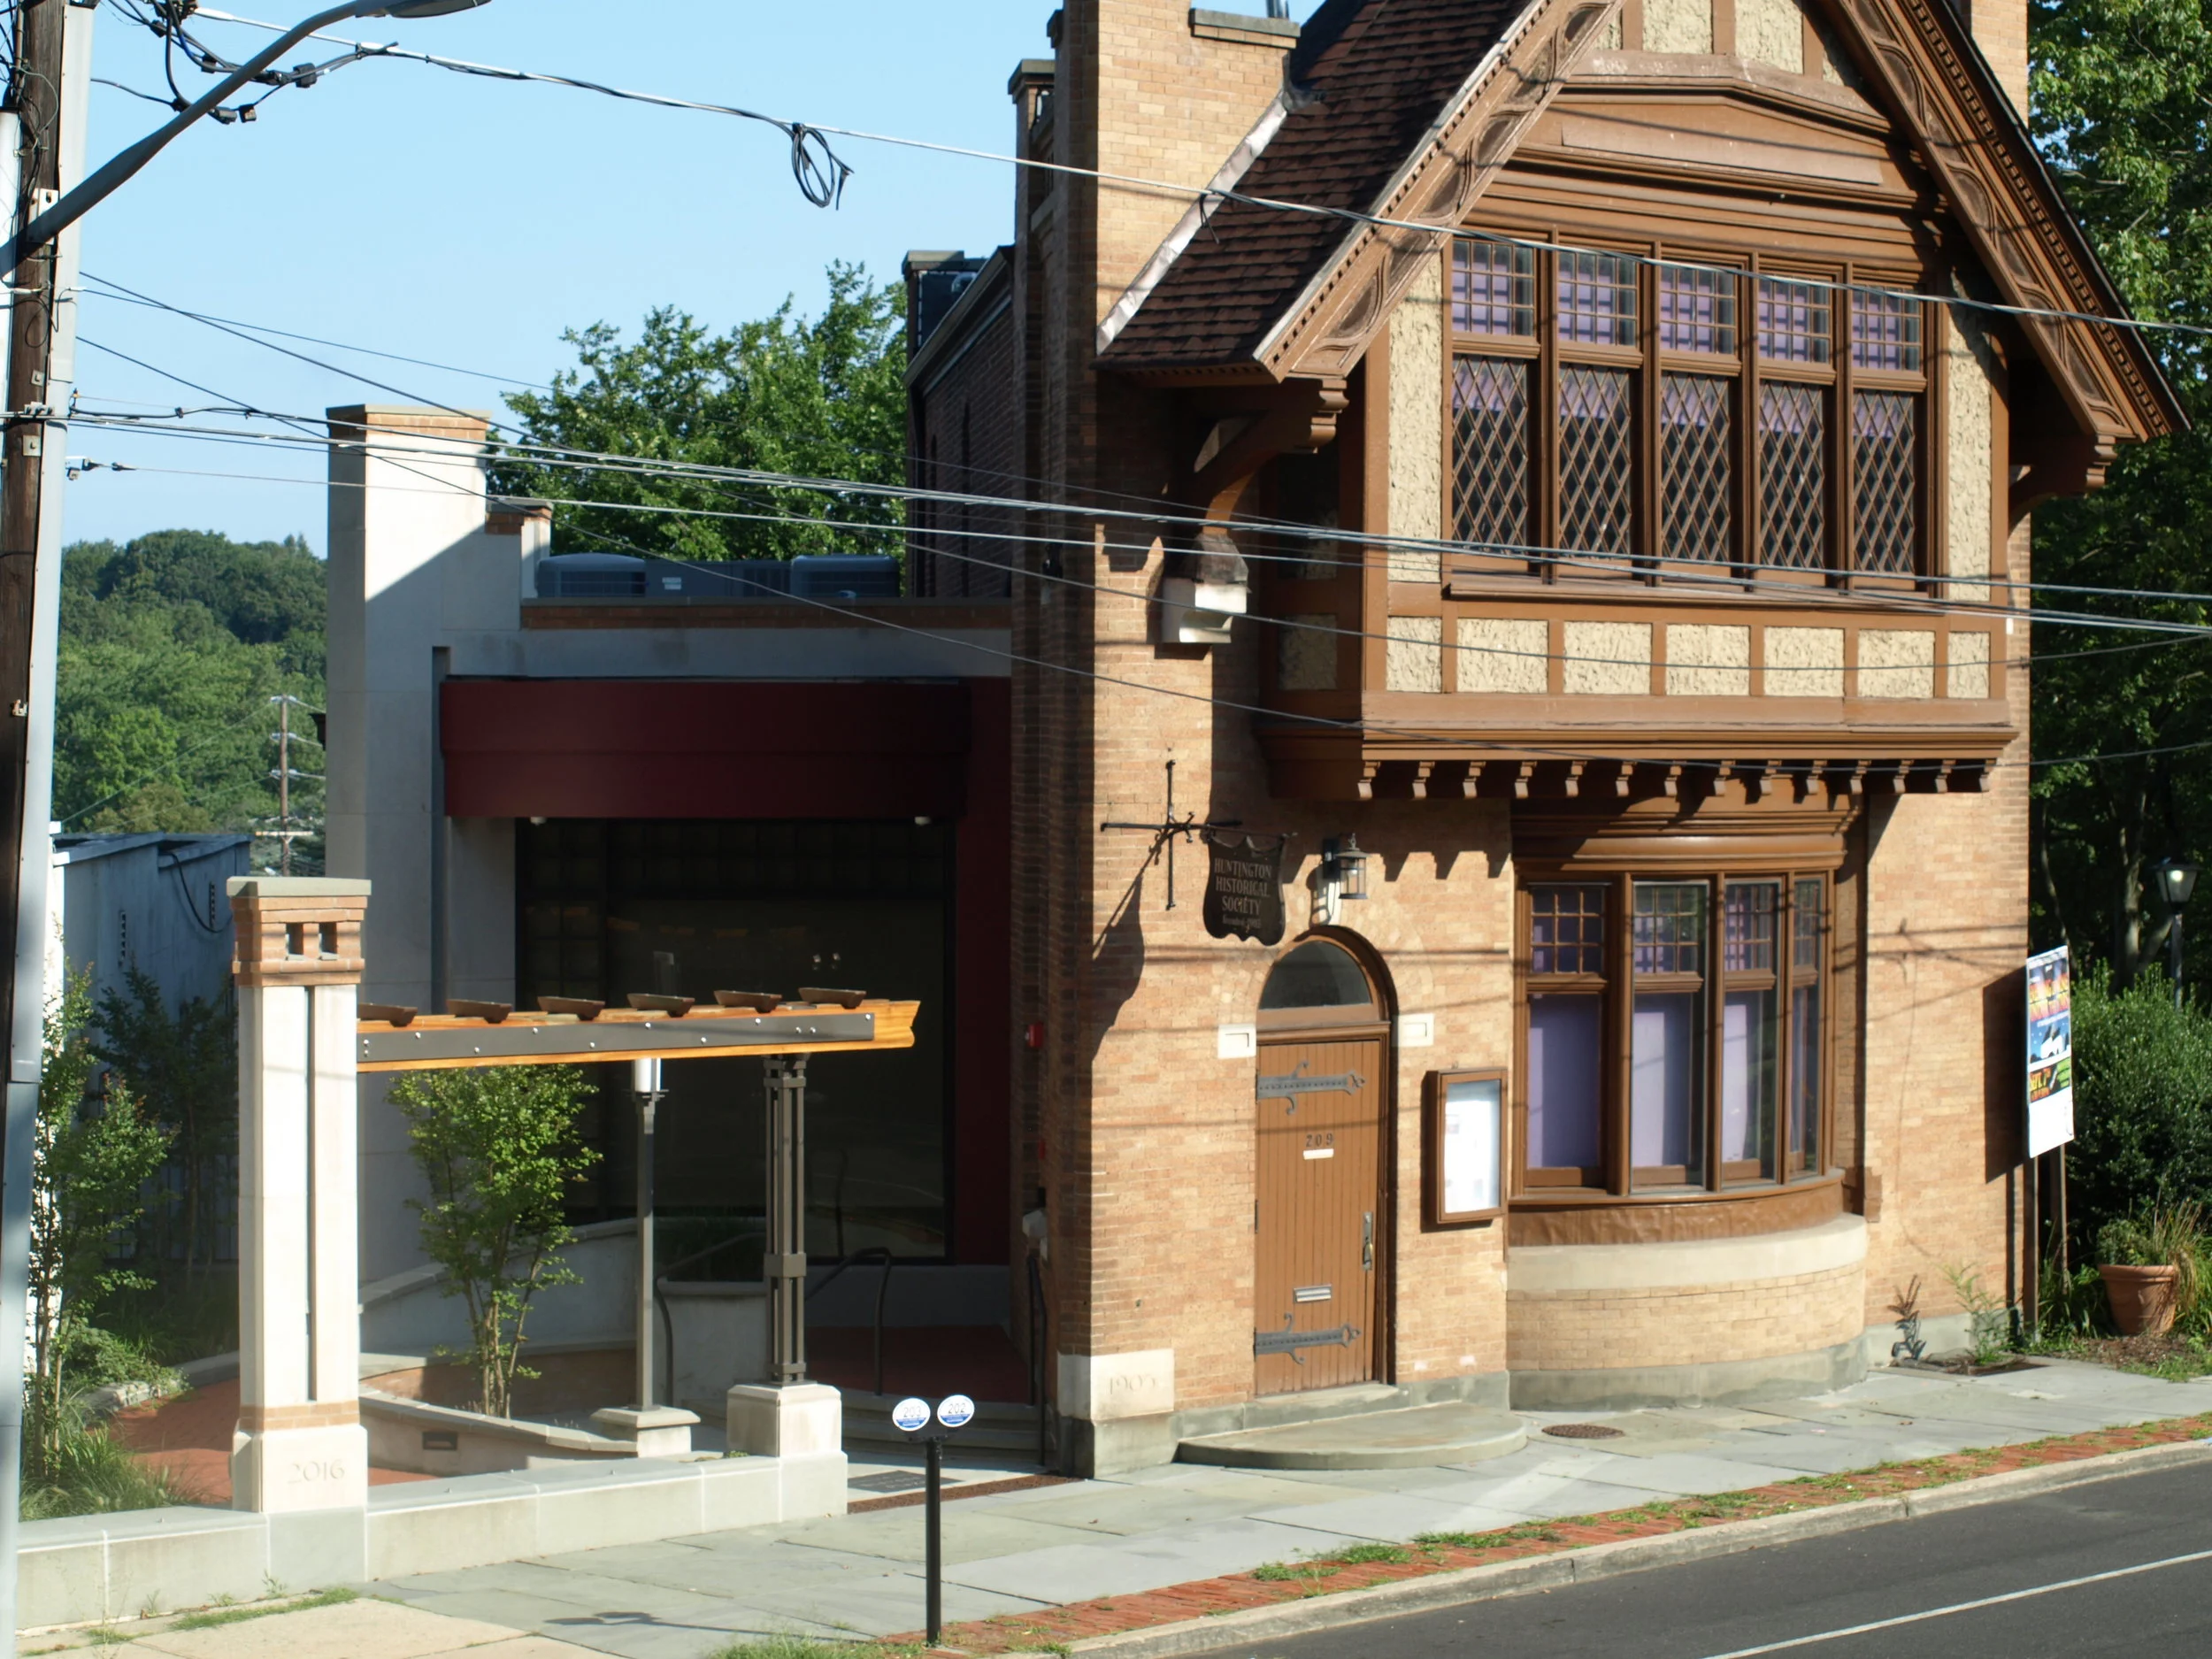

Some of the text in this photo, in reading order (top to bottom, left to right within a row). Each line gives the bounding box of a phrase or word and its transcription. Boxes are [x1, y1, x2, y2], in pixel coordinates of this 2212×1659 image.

[1214, 857, 1272, 879] HUNTINGTON
[1216, 875, 1271, 898] HISTORICAL
[1222, 895, 1261, 916] SOCIETY
[1306, 1133, 1333, 1148] 209
[948, 1402, 966, 1414] 202
[287, 1458, 345, 1485] 2016
